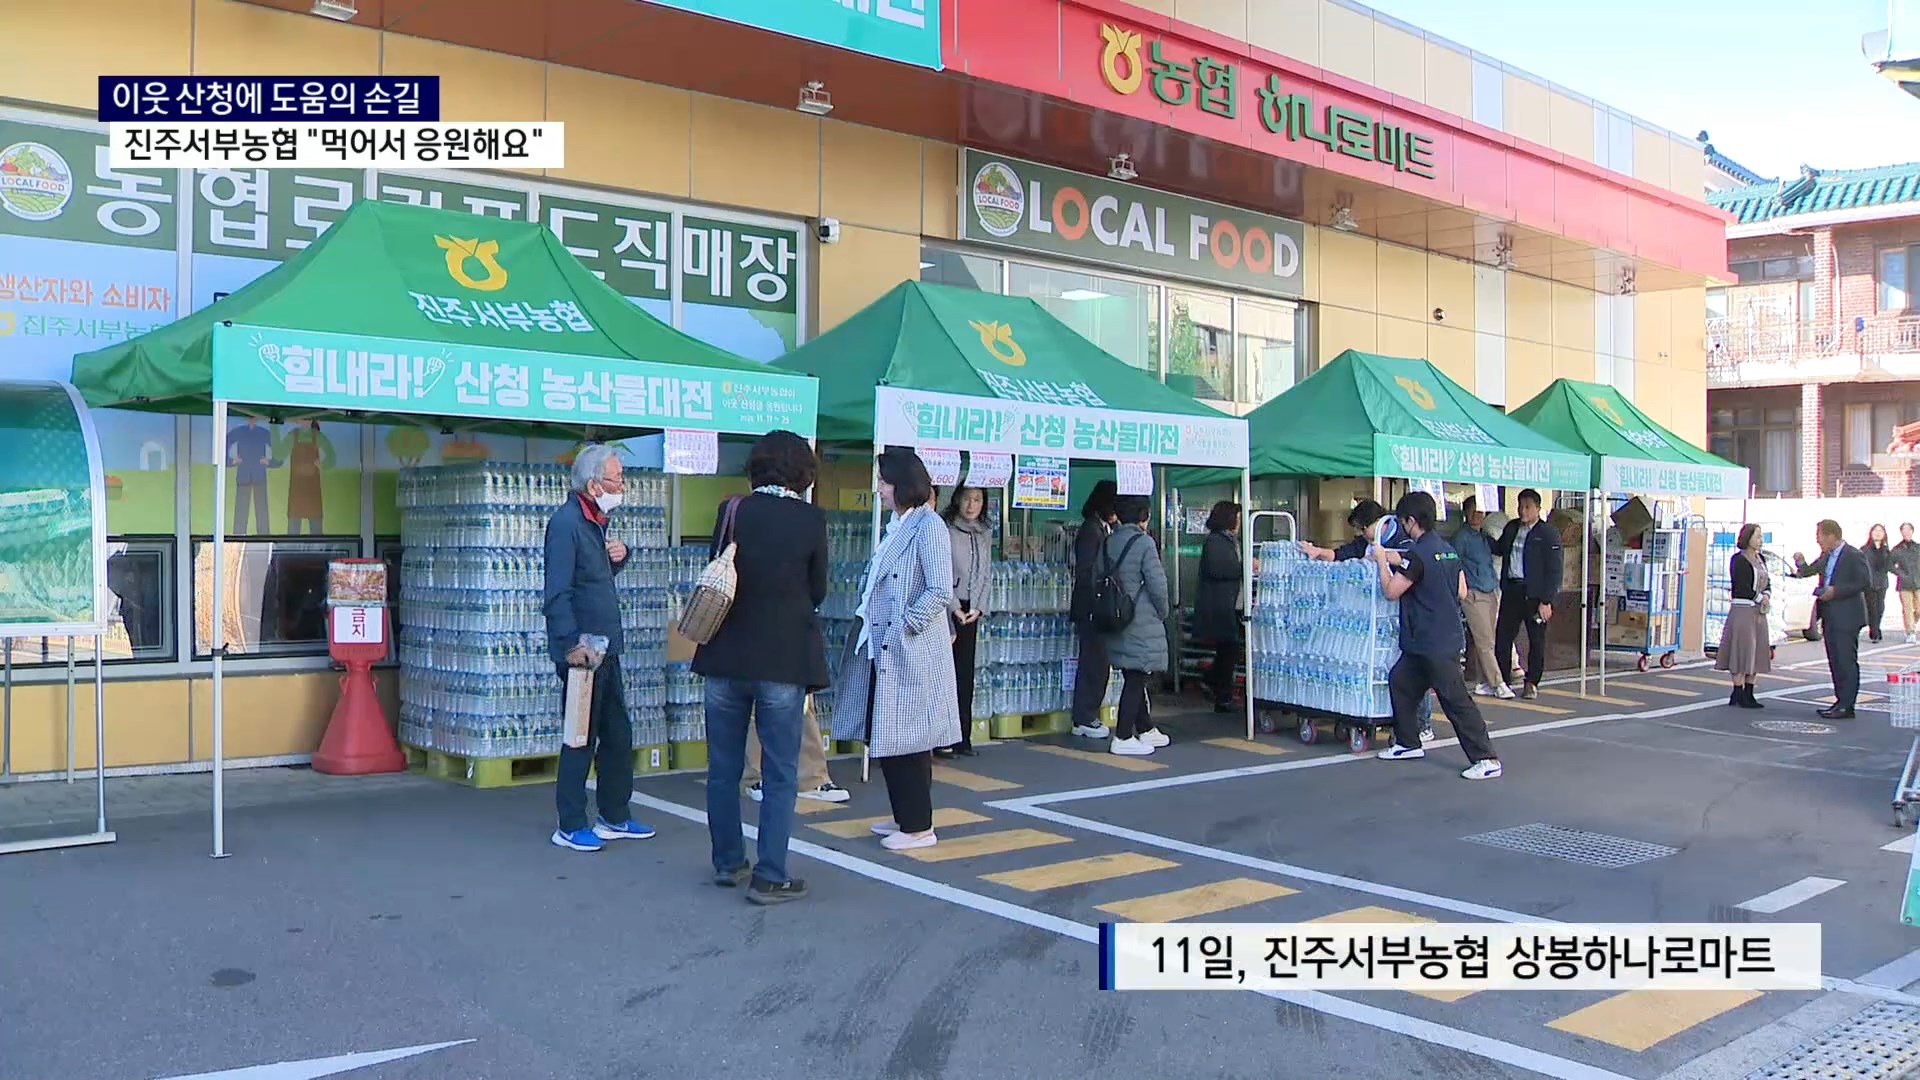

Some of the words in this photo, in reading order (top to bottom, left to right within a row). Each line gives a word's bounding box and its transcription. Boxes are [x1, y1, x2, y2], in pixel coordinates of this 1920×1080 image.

[1149, 40, 1238, 120] 농협
[1256, 73, 1436, 180] 하나로마트
[2, 177, 34, 188] LOCAL
[36, 181, 65, 191] FOOD
[978, 195, 1000, 206] LOCAL
[1029, 180, 1175, 257] LOCAL
[1190, 214, 1300, 278] FOOD
[0, 271, 94, 307] 생산자와
[101, 282, 172, 313] 소비자
[408, 290, 595, 334] 진주서부농협
[281, 345, 425, 400] 힘내라!
[454, 360, 529, 408] 산청
[540, 367, 713, 421] 농산물대전
[915, 402, 1003, 443] 힘내라!
[1019, 412, 1066, 448] 산청
[1073, 417, 1180, 456] 농산물대전
[1457, 451, 1485, 478] 산청
[1488, 455, 1550, 483] 농산물대전
